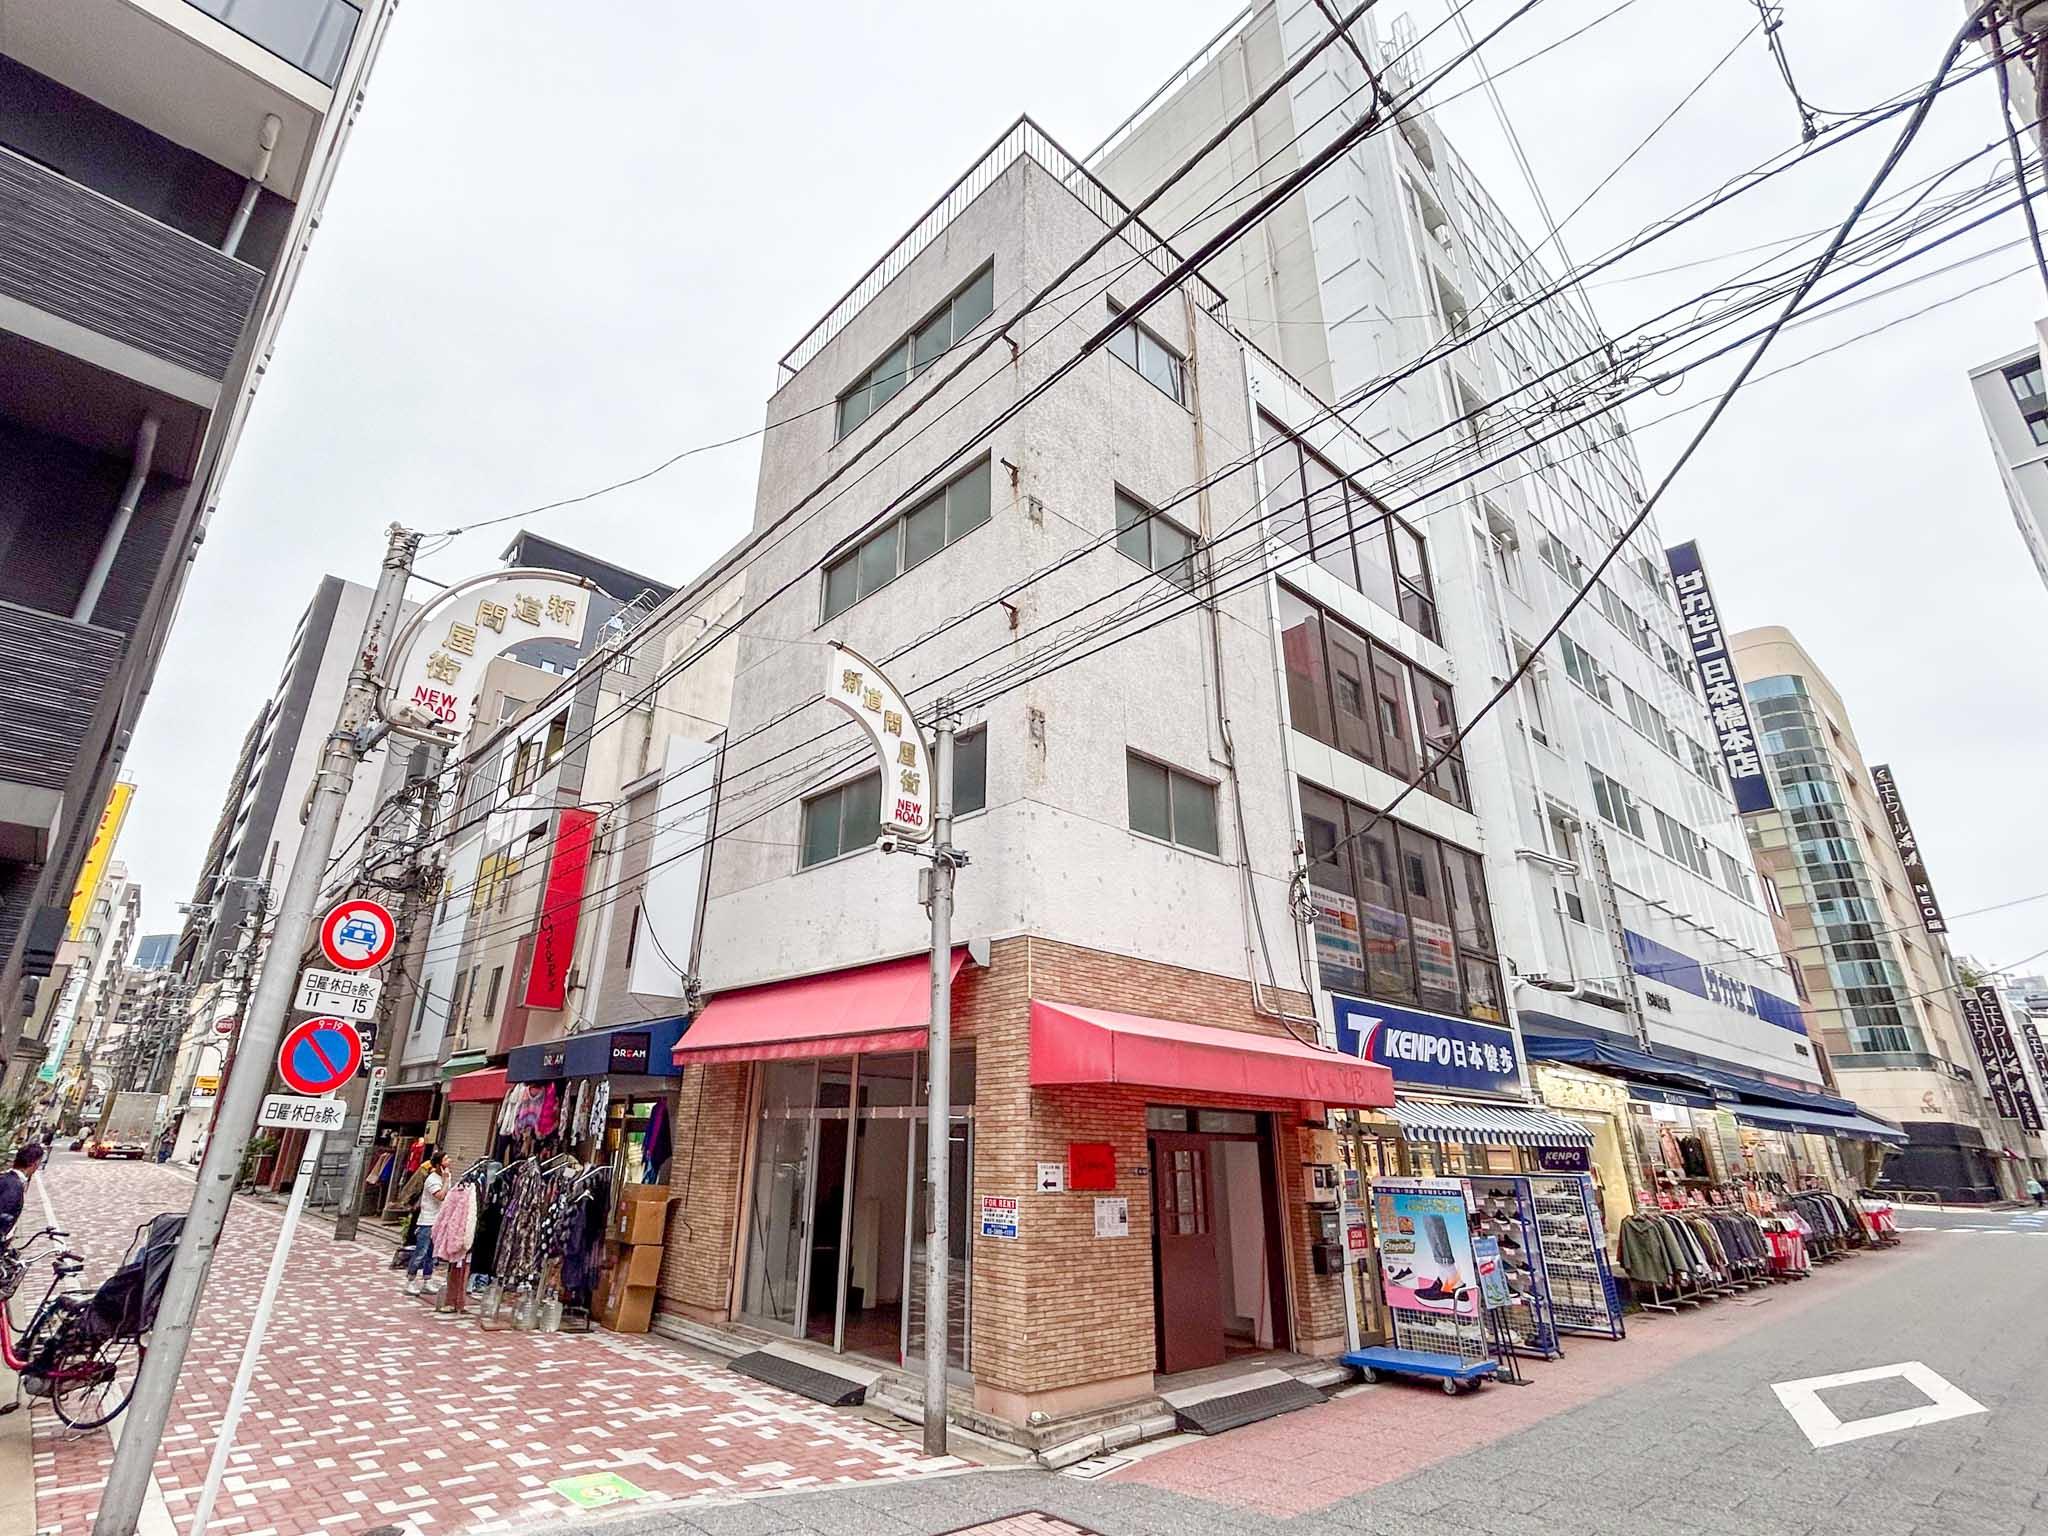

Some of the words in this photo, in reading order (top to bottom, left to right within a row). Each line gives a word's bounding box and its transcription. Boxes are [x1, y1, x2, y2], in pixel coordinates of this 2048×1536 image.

[1676, 571, 1724, 657] サカゼン
[1701, 657, 1760, 779] 日本橋本店
[415, 685, 458, 708] NEW
[841, 669, 921, 796] 新道問屋街
[894, 808, 923, 826] ROAD
[897, 798, 922, 815] NEW
[306, 974, 376, 998] 日曜・休日を除く
[305, 991, 320, 1007] 11
[352, 999, 367, 1014] 15
[612, 1048, 647, 1058] DREAM
[265, 1102, 342, 1124] 日曜・休日を除く
[1545, 1151, 1581, 1161] KENPO
[999, 1199, 1016, 1209] RENT
